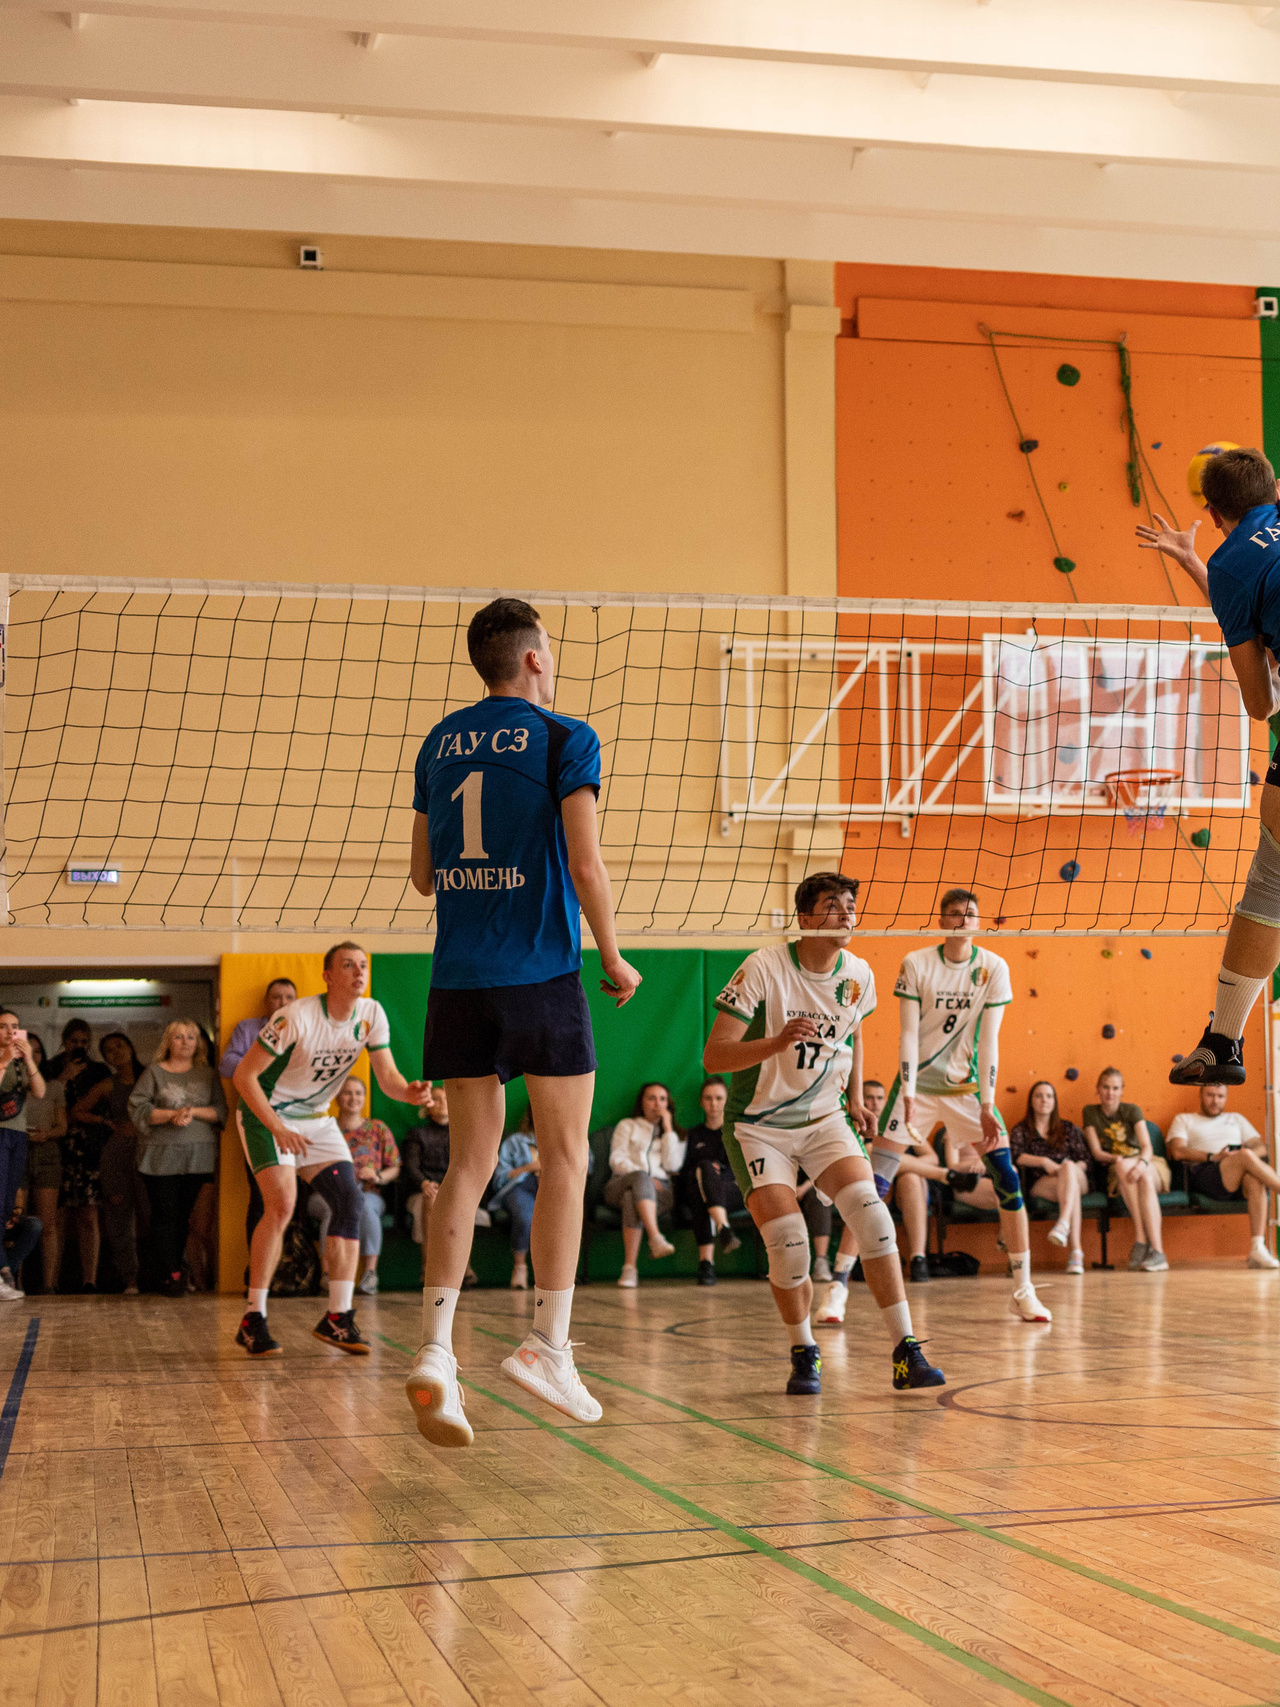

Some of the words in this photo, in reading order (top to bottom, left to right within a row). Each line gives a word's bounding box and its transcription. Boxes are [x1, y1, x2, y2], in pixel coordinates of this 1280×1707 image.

[436, 731, 487, 760] ГАУ
[491, 727, 530, 753] СЗ
[451, 771, 490, 860] 1
[435, 866, 526, 891] ТЮМЕНЬ
[935, 998, 971, 1010] ГСХА
[942, 1014, 957, 1034] 8
[794, 1041, 824, 1069] 17
[889, 1119, 899, 1131] 8
[748, 1158, 766, 1176] 17
